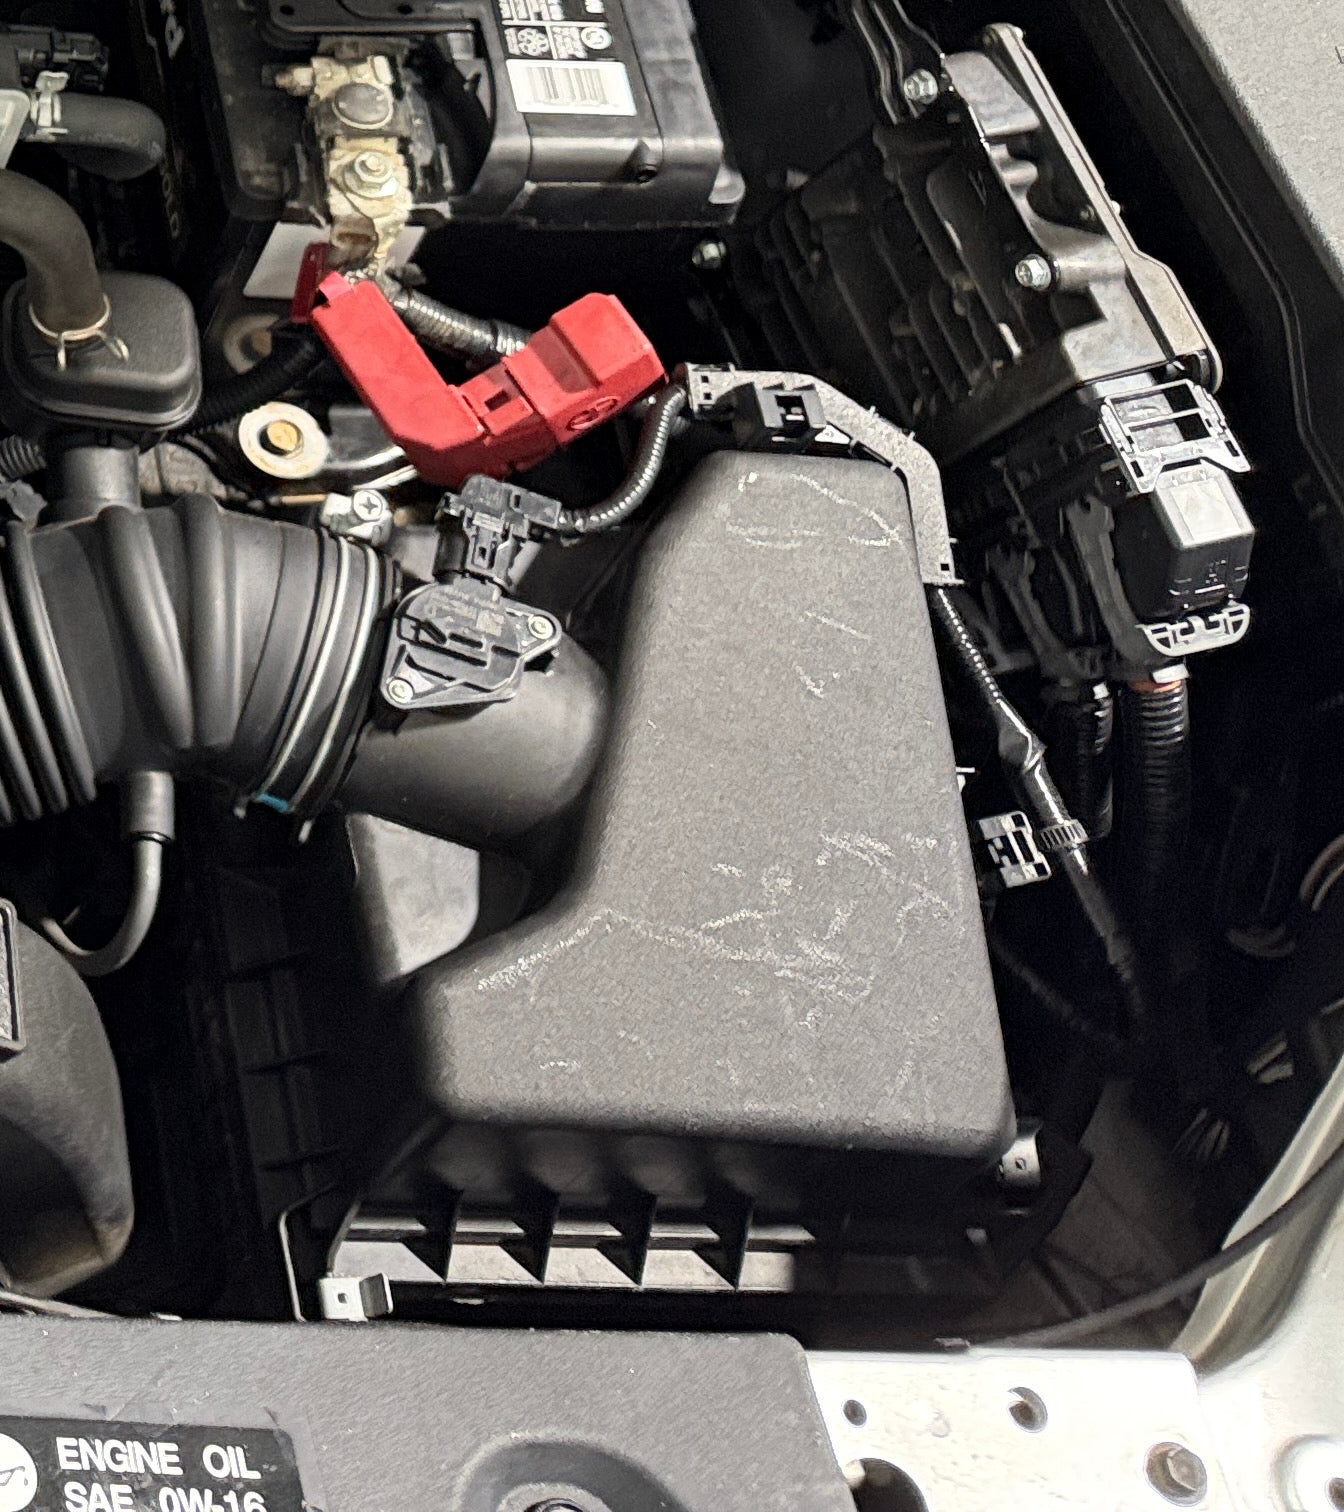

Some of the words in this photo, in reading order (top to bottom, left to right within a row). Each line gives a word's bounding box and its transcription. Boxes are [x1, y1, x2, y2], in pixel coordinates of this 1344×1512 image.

[56, 1436, 184, 1476] ENGINE
[202, 1444, 262, 1480] OIL
[63, 1481, 136, 1512] SAE
[158, 1486, 268, 1512] 0W-16
